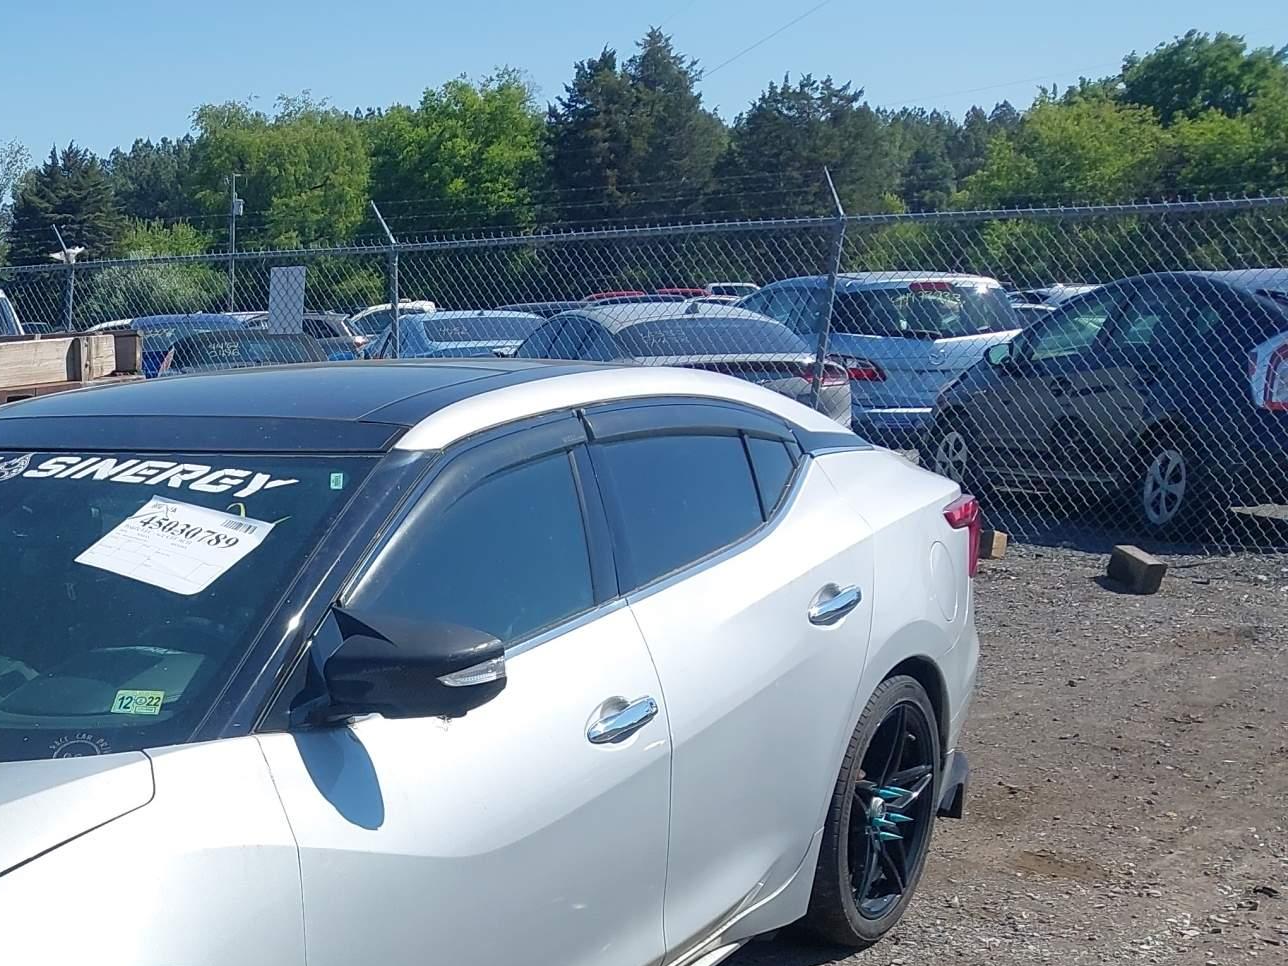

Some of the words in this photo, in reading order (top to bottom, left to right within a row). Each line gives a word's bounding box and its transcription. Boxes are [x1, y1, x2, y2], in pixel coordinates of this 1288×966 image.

[27, 455, 300, 498] SINERGY
[140, 515, 240, 549] 45030789
[118, 696, 132, 709] 12
[146, 696, 161, 706] 22
